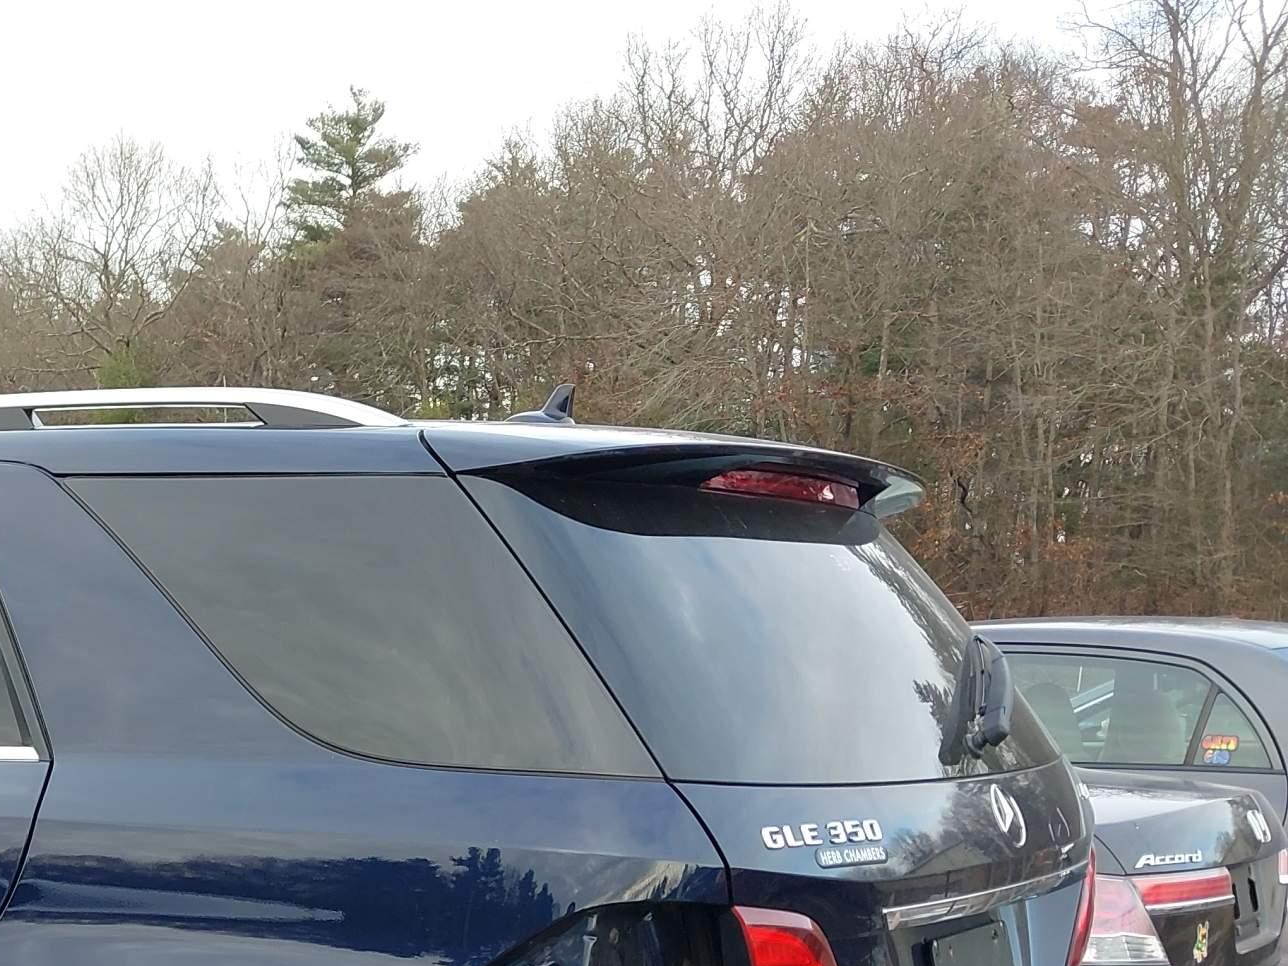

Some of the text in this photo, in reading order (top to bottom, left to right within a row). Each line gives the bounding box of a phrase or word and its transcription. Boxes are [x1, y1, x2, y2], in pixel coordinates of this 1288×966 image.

[761, 819, 883, 849] GLE 350
[819, 847, 886, 865] HERB CHAMBERS
[1135, 849, 1203, 868] Accord
